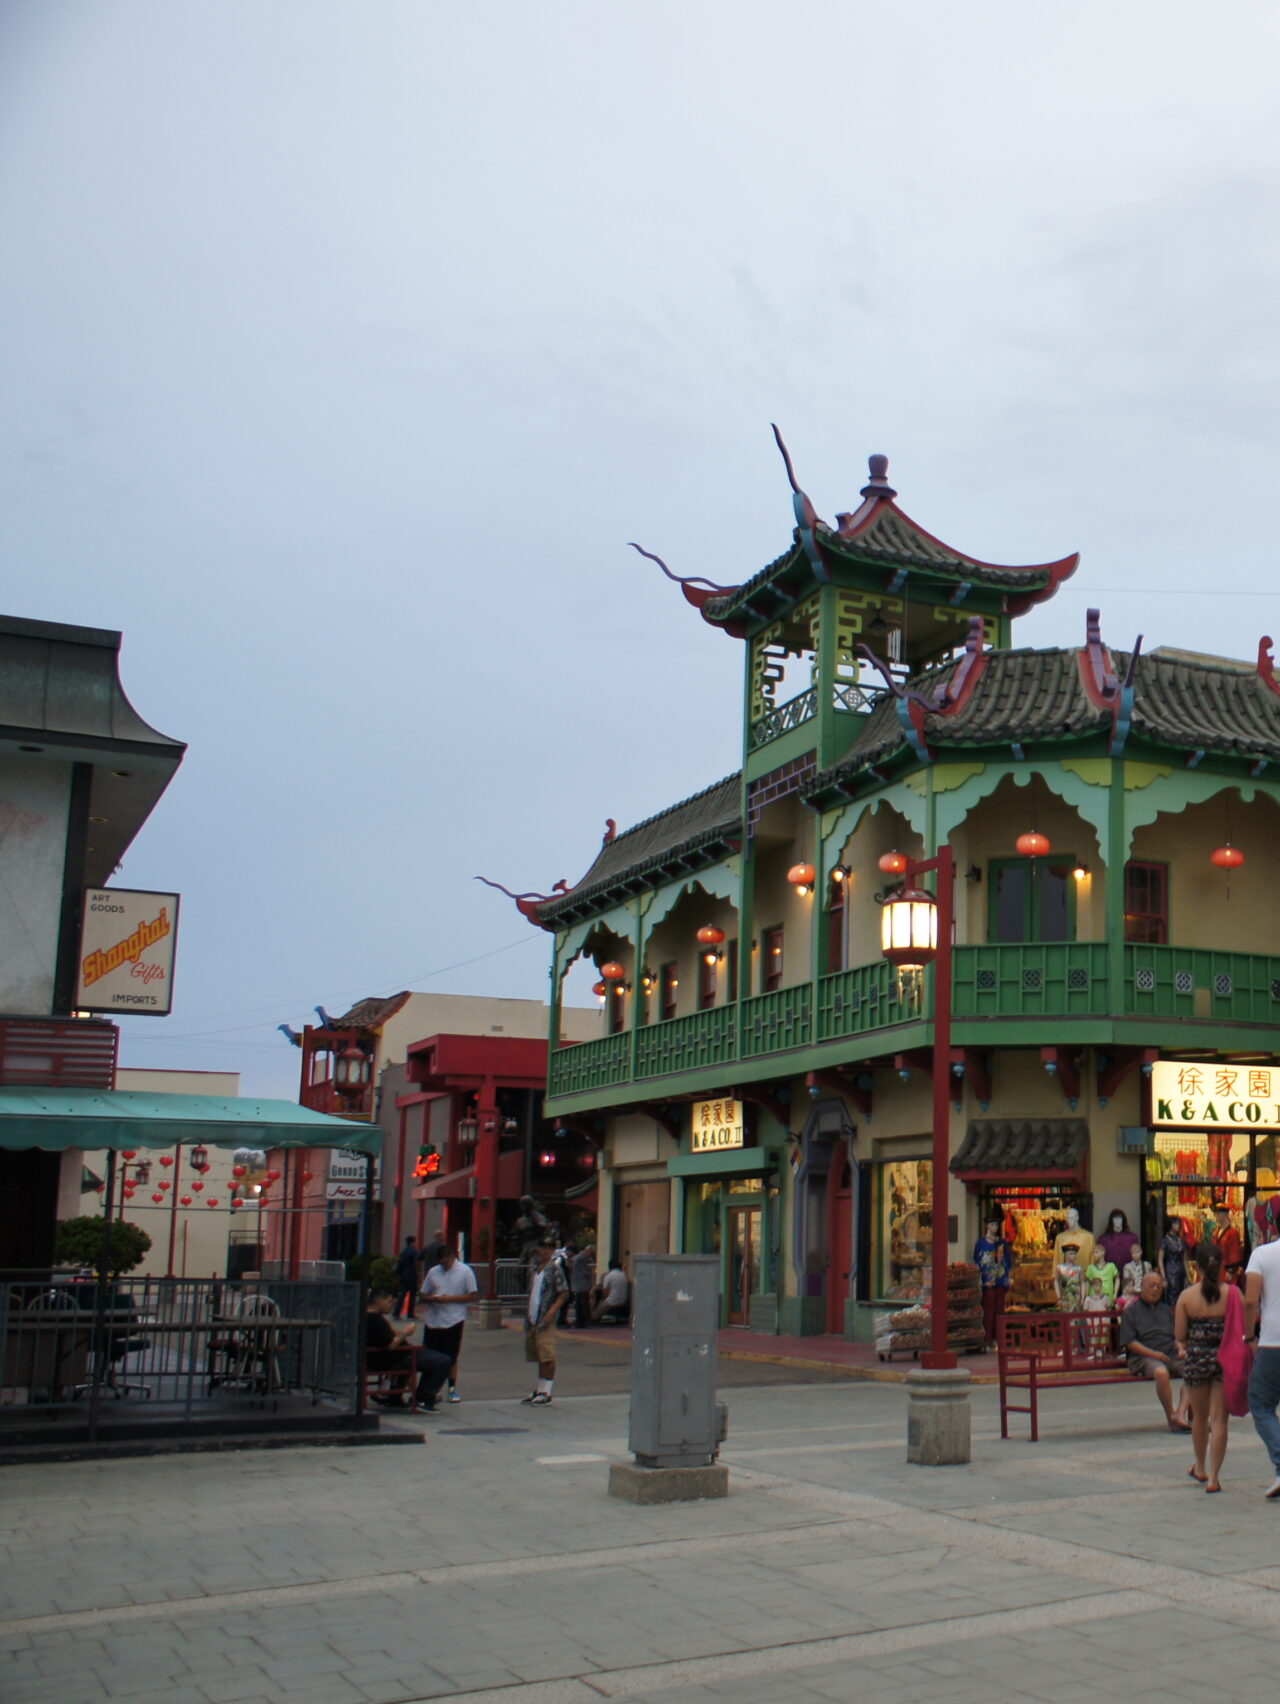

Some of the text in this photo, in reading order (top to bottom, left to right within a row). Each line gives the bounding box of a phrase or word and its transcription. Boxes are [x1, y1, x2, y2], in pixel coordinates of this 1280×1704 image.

[90, 904, 125, 913] GOODS
[91, 894, 111, 902] ART
[82, 906, 170, 988] Shanghai
[130, 961, 167, 985] Gifts
[112, 994, 158, 1005] IMPORTS
[1177, 1067, 1272, 1099] 徐家園
[1157, 1098, 1174, 1120] K
[1180, 1100, 1197, 1121] &
[1202, 1101, 1220, 1122] A
[1227, 1101, 1268, 1124] CO.
